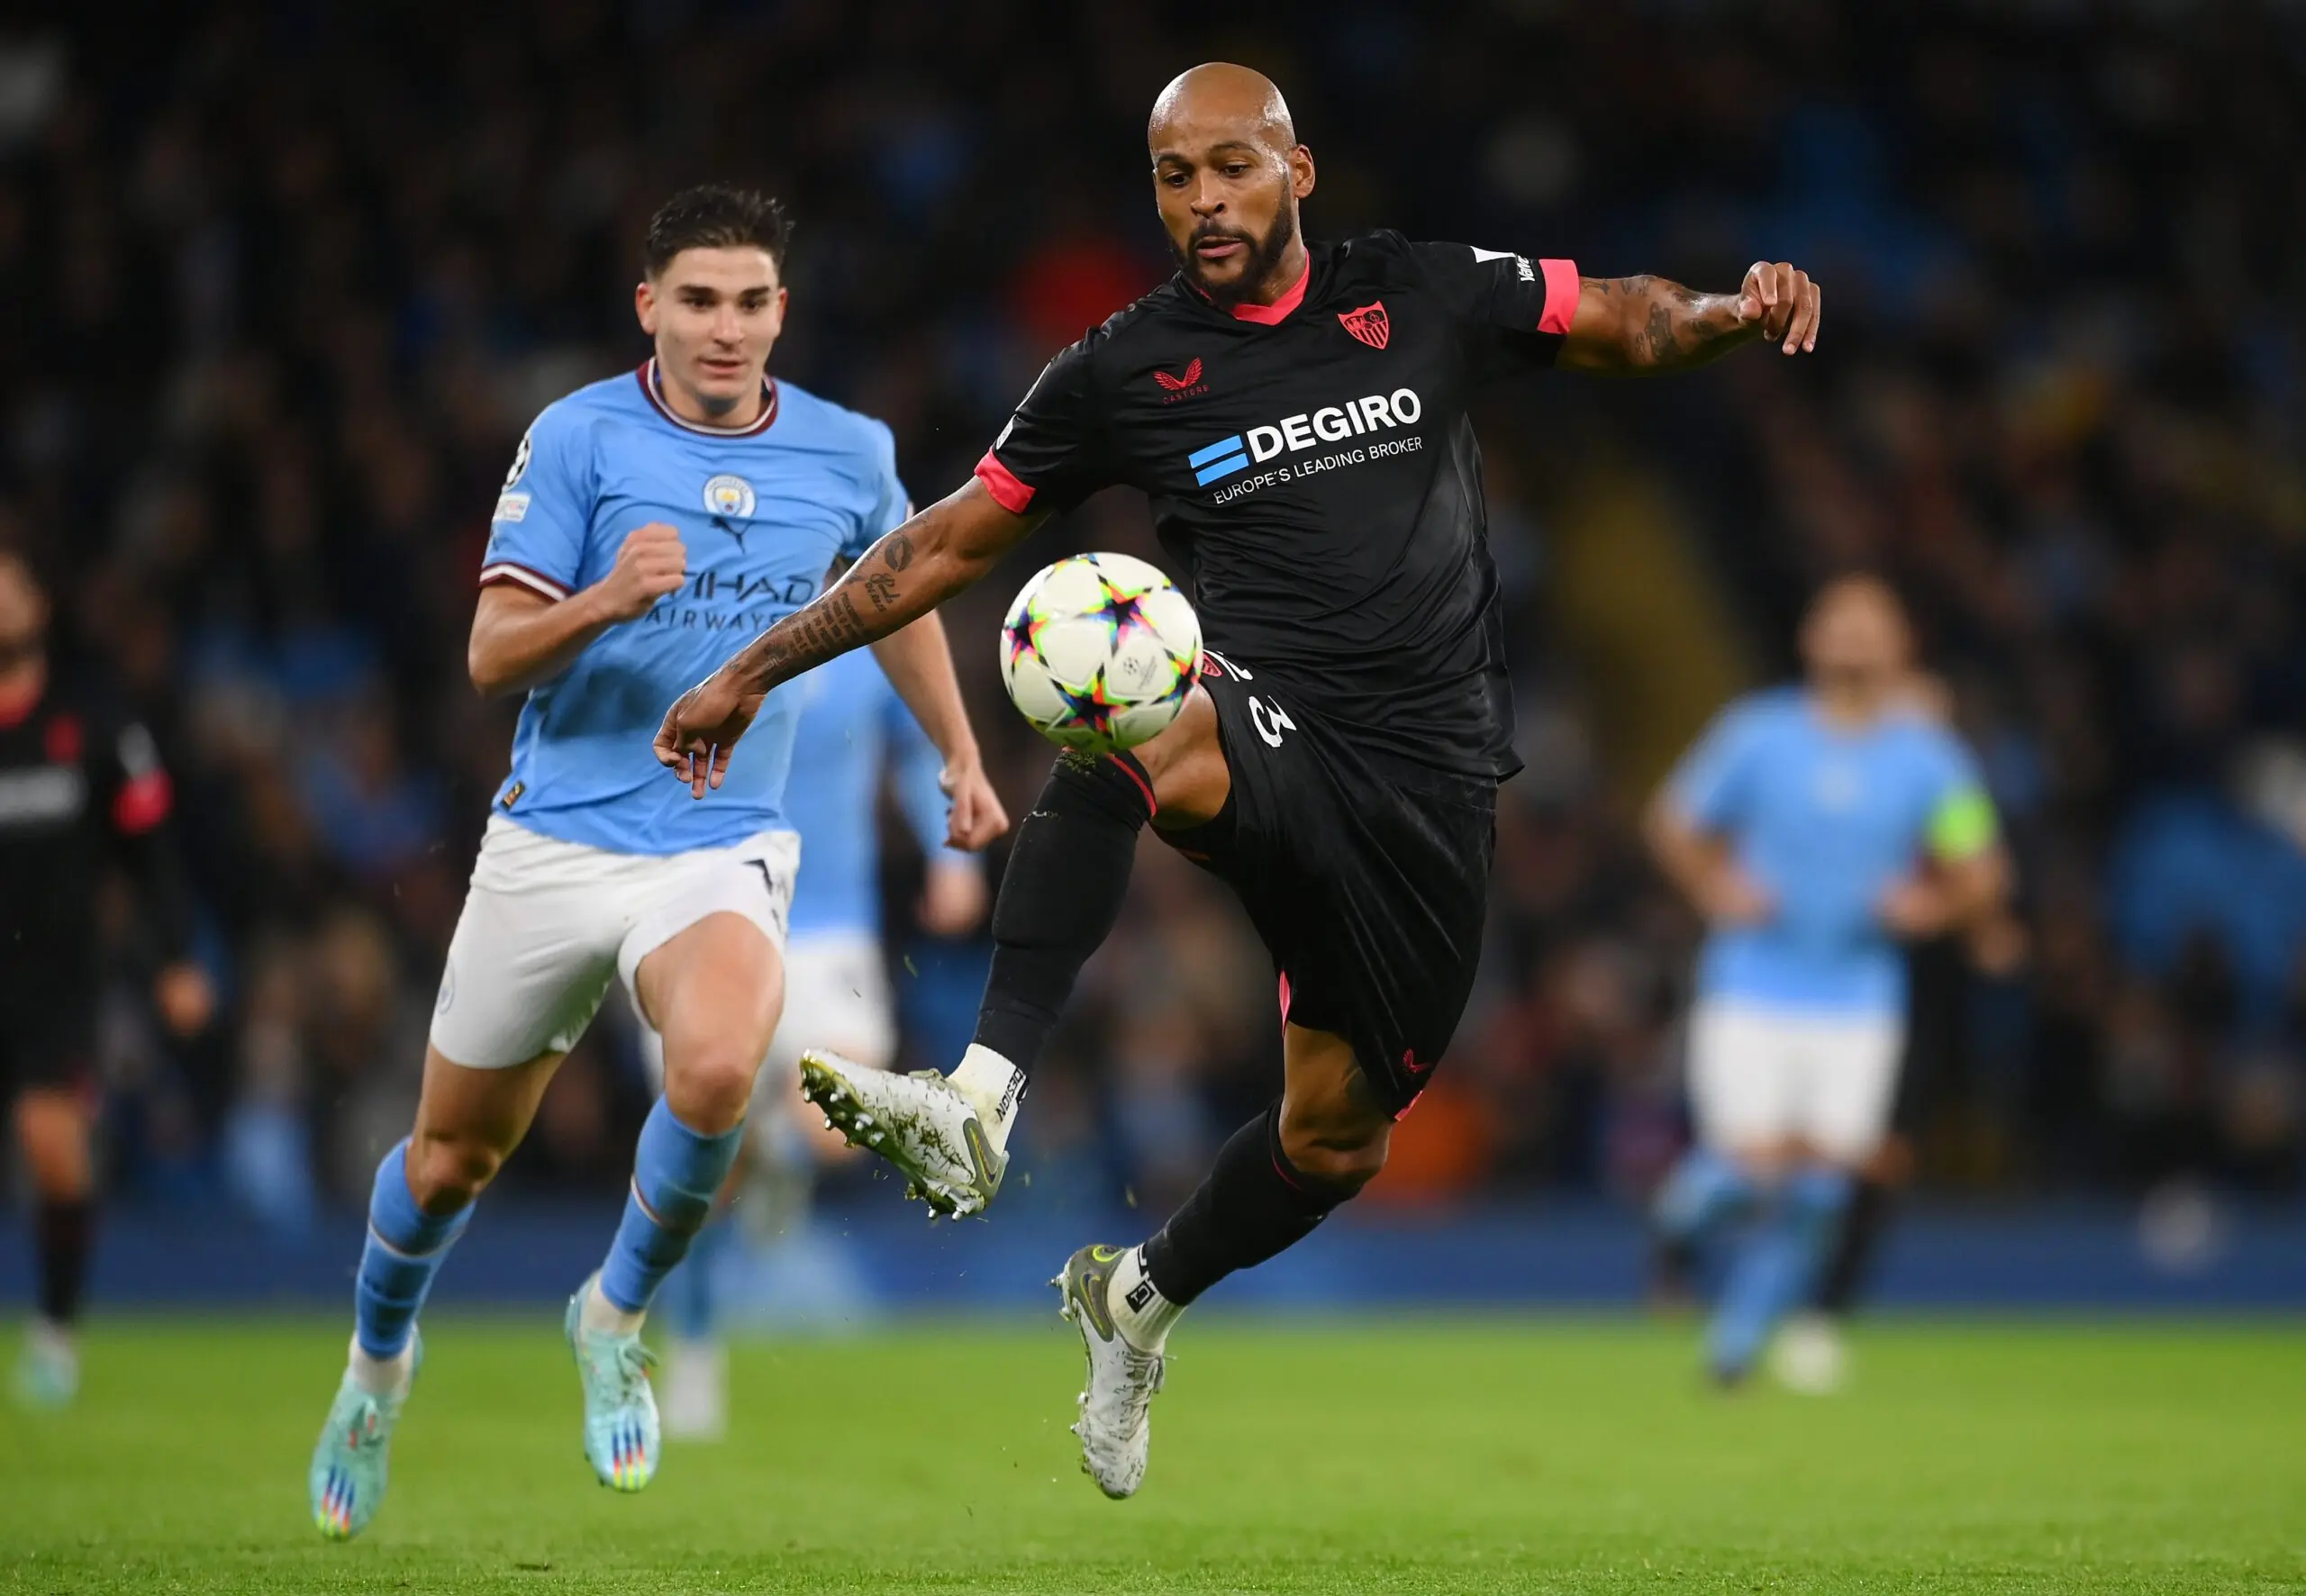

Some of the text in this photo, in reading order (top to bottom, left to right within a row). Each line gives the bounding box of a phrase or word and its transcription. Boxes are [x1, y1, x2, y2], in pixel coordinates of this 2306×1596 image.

[1163, 385, 1210, 404] CASTORE
[1247, 388, 1421, 464] DEGIRO
[1294, 449, 1366, 478] LEADING
[1368, 436, 1423, 459] BROKER
[994, 1068, 1023, 1123] DESIGN
